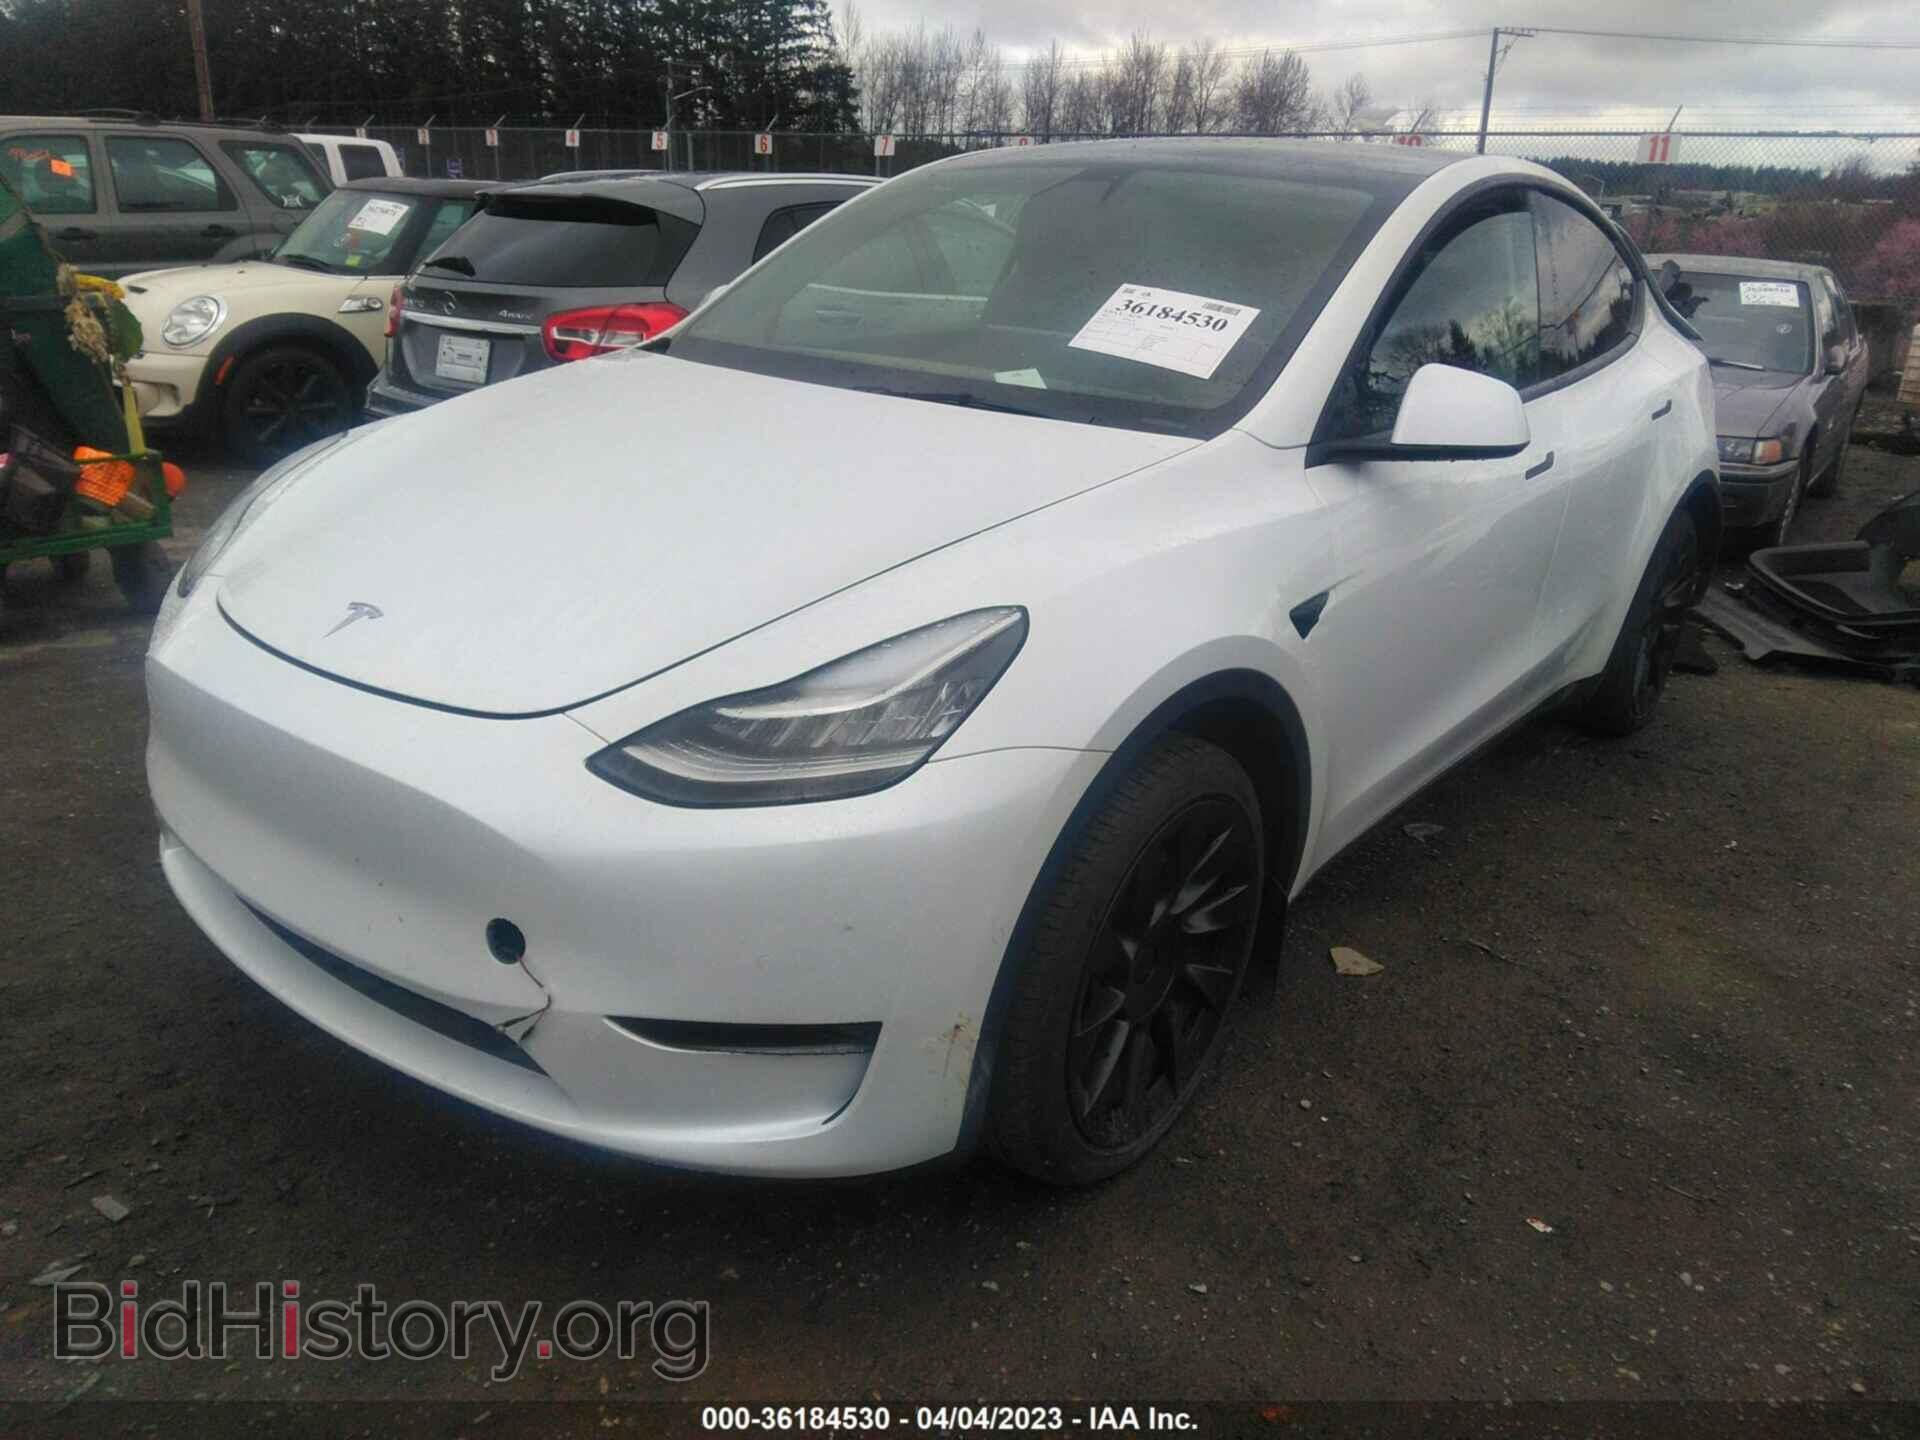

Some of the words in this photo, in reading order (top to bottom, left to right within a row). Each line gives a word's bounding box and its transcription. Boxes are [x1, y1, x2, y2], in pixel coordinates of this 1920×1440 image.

[655, 131, 664, 149] 5
[760, 135, 768, 153] 6
[881, 136, 889, 155] 7
[1647, 135, 1671, 162] 11
[1115, 299, 1229, 333] 36184530
